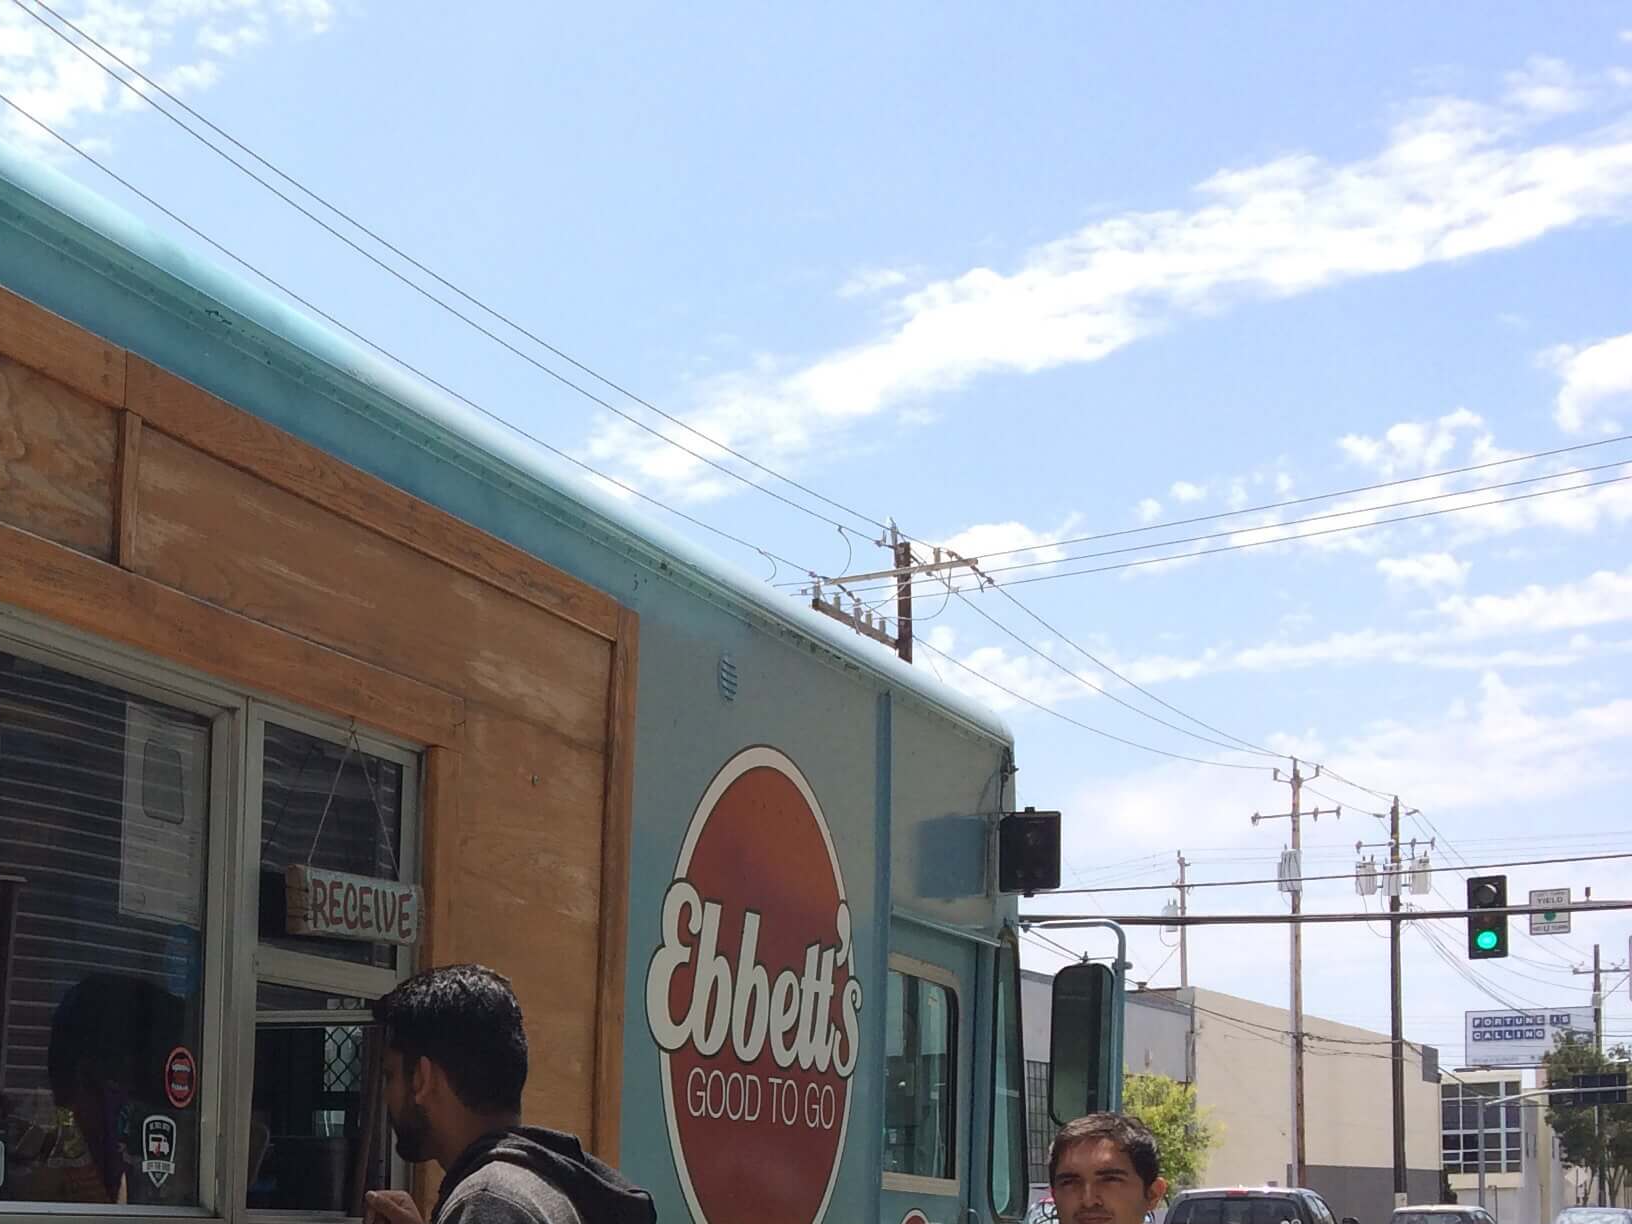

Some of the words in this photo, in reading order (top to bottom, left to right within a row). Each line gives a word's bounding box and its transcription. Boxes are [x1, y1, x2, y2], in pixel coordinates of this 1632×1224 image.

[311, 879, 413, 938] RECEIVE
[1536, 896, 1564, 905] YIELD
[645, 881, 863, 1077] Ebbett's
[1472, 1015, 1546, 1029] FORTUNE
[1472, 1028, 1546, 1042] CALLING
[687, 1066, 761, 1121] GOOD
[768, 1077, 798, 1125] TO
[804, 1083, 836, 1131] GO
